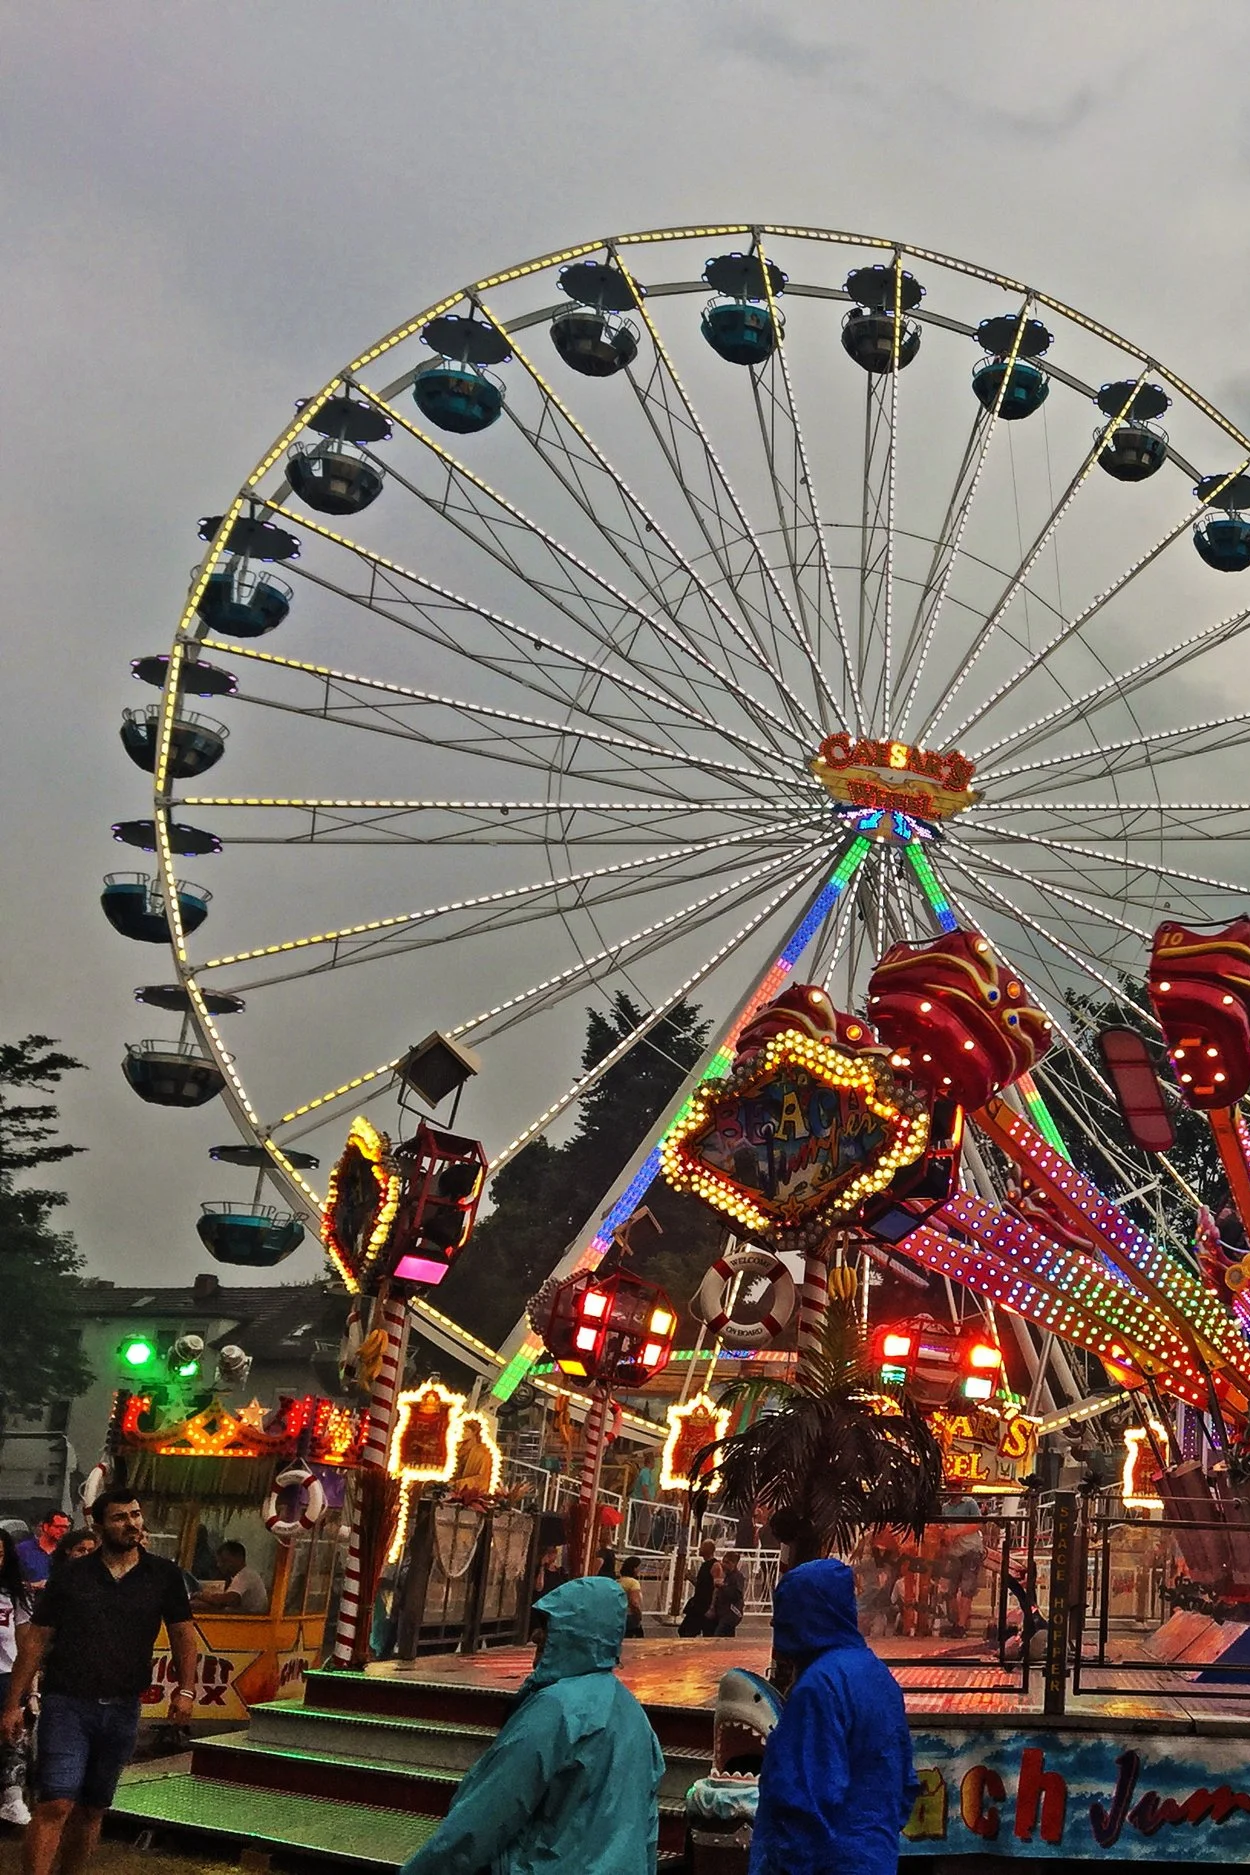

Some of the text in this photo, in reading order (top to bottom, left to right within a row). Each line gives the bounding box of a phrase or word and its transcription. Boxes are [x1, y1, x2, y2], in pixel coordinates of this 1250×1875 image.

[1161, 931, 1184, 947] 10
[737, 1327, 763, 1337] BOARD
[139, 1685, 228, 1705] BX
[901, 1746, 1068, 1846] ach
